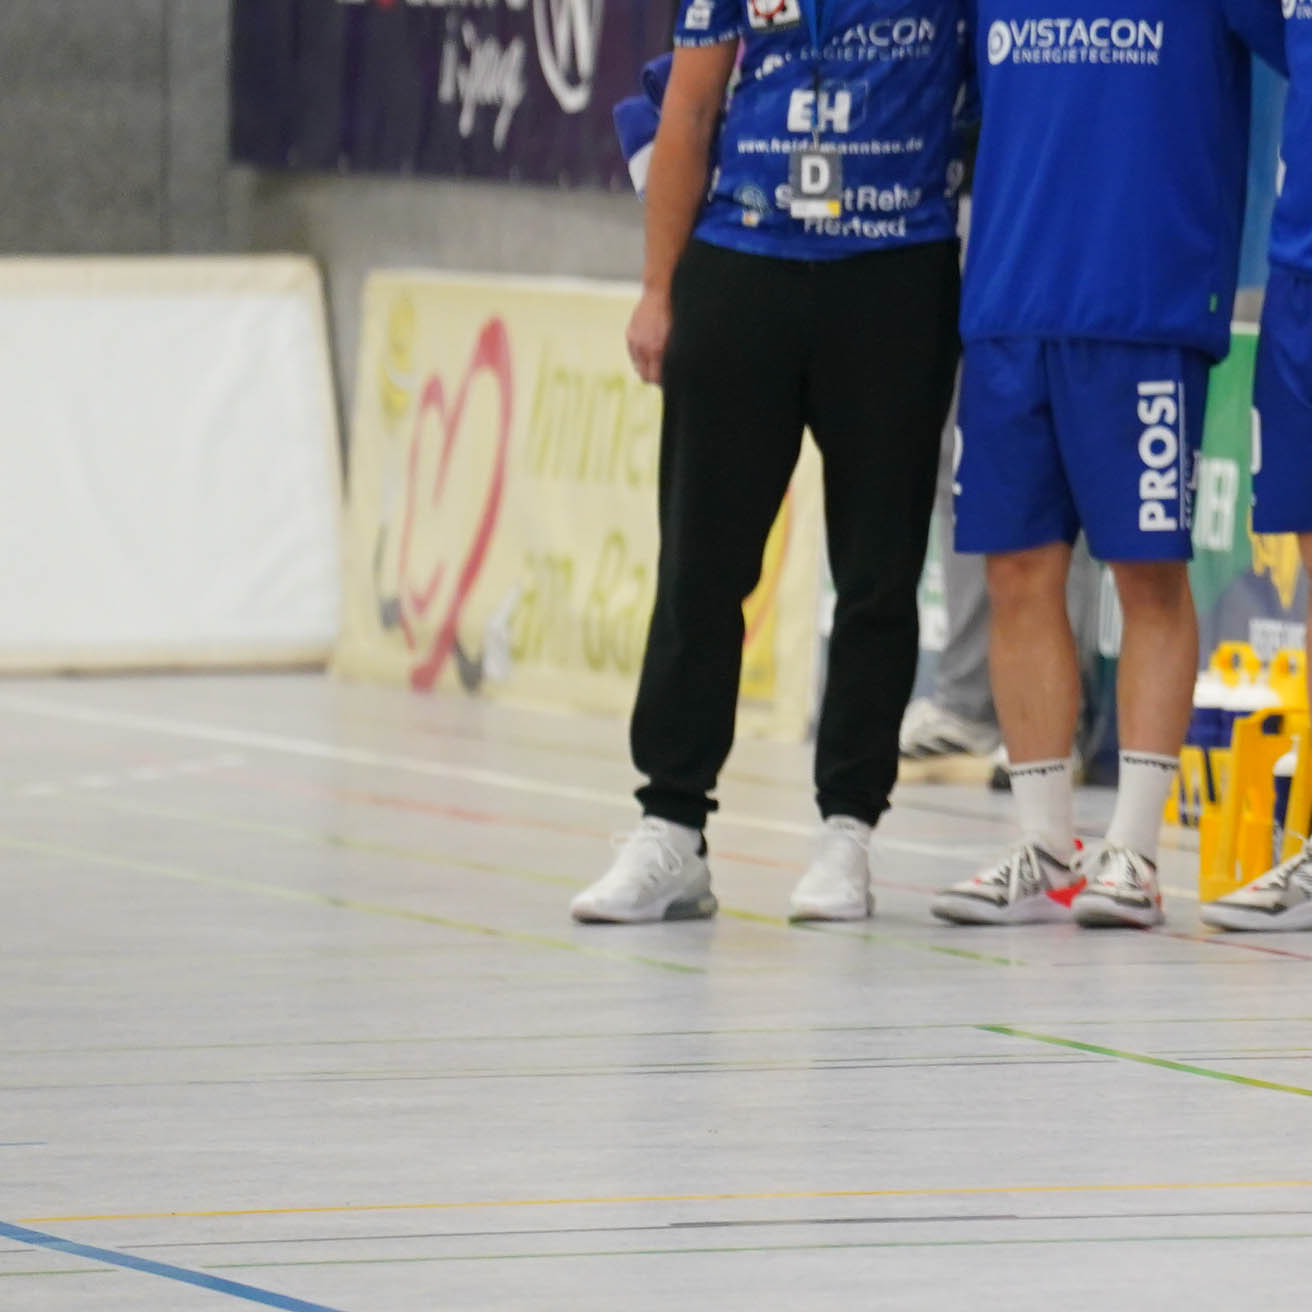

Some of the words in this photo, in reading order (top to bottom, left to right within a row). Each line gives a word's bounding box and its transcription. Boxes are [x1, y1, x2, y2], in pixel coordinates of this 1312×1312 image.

[1010, 18, 1163, 50] VISTACON
[1012, 47, 1160, 66] ENERGIETECHNIK
[800, 155, 831, 194] D
[1137, 380, 1178, 532] PROSI
